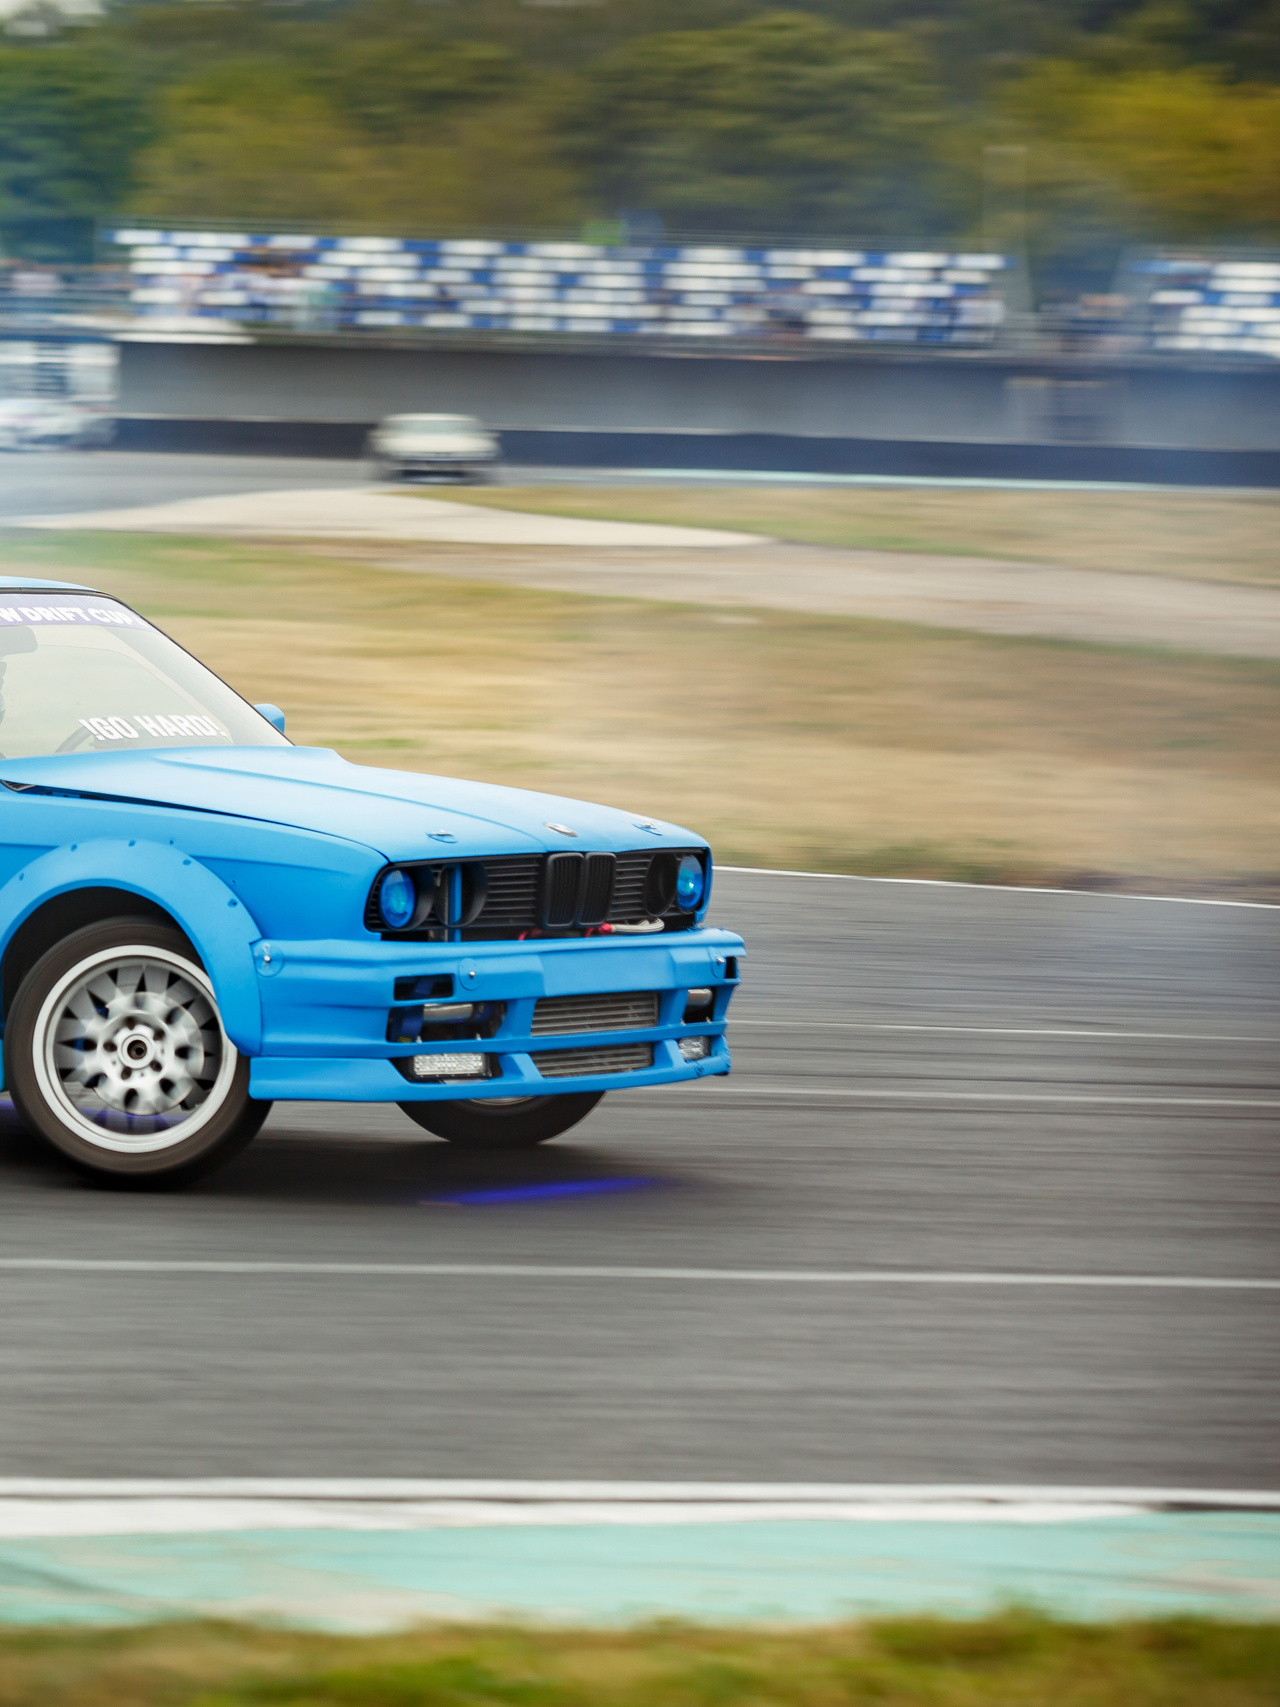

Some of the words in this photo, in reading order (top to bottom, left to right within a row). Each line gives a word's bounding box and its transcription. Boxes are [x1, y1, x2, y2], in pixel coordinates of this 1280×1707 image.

[17, 606, 91, 622] DRIFT
[87, 607, 134, 626] CUP
[133, 714, 228, 738] HARD!
